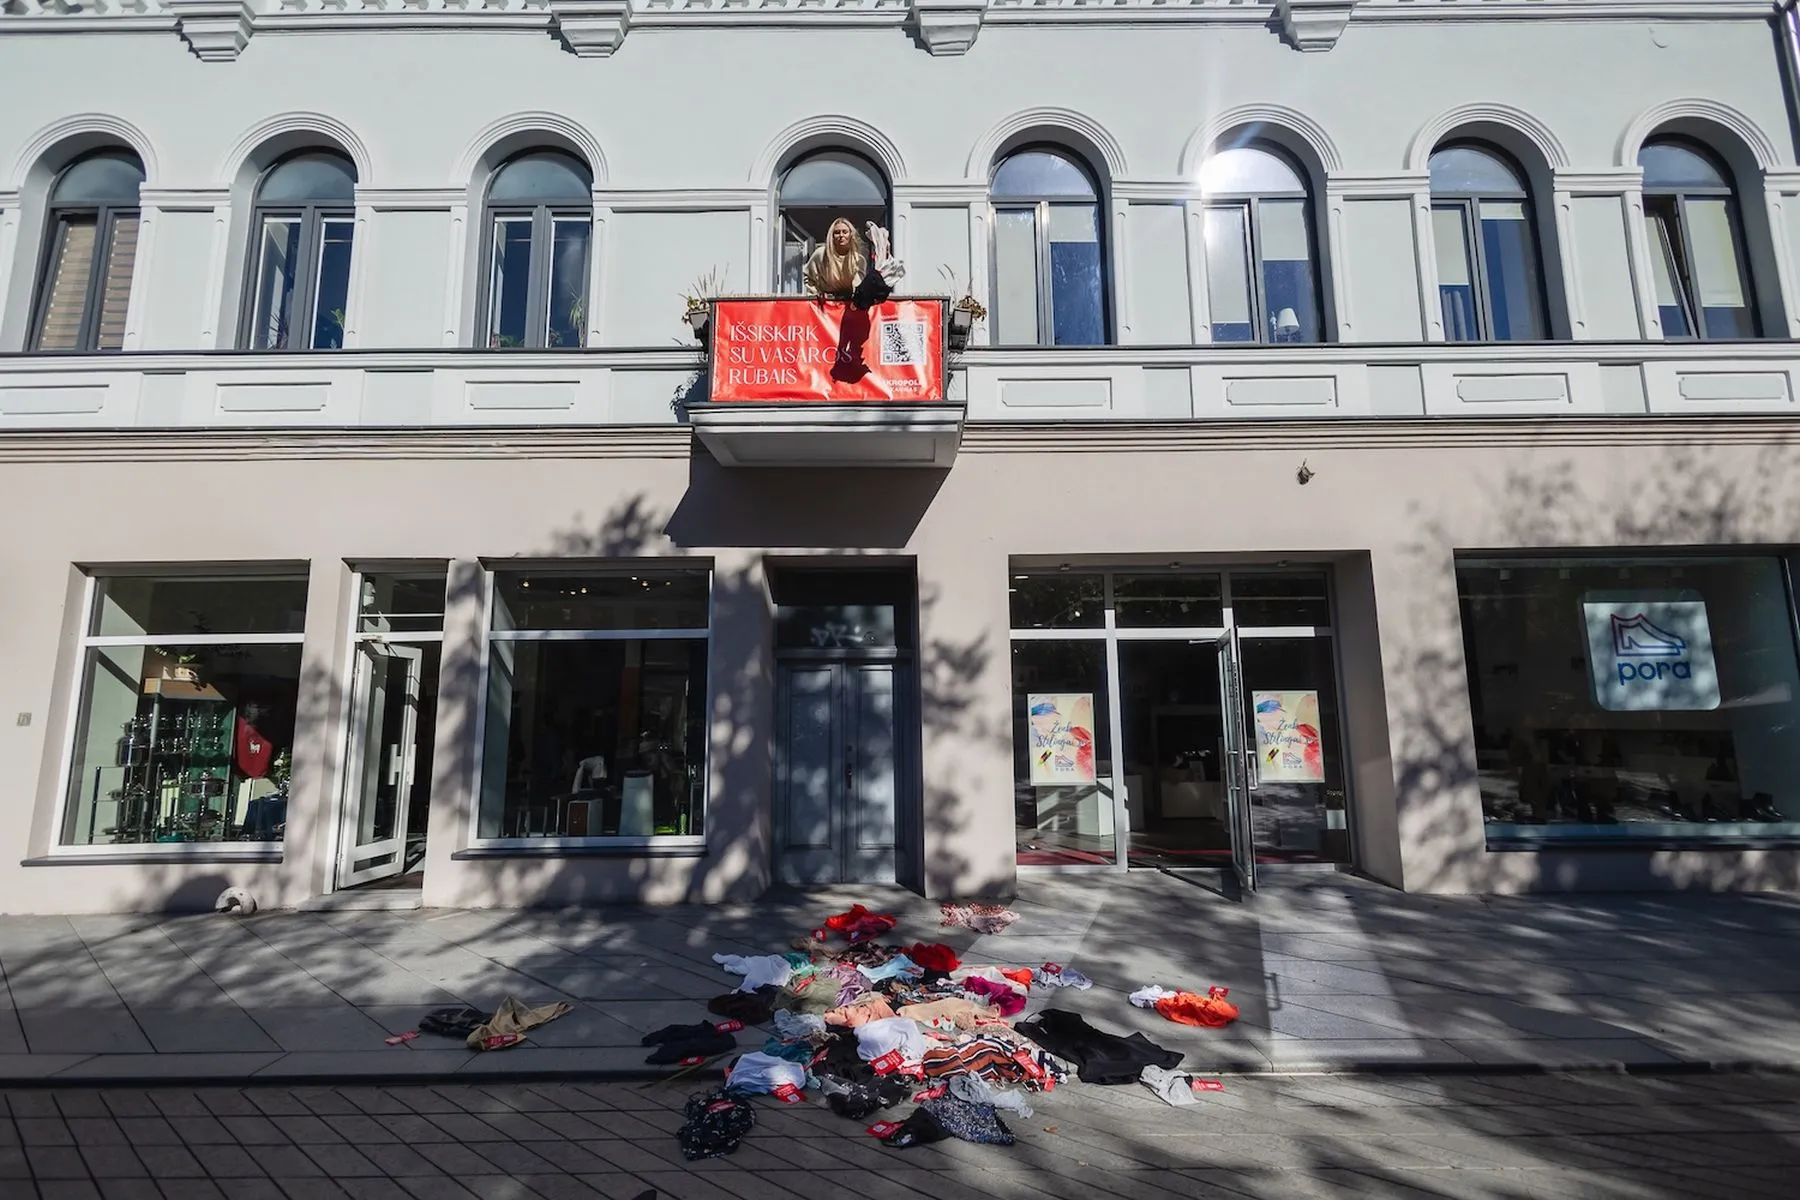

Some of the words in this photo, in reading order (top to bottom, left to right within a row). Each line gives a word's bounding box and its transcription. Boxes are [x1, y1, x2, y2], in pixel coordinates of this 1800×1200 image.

[730, 321, 820, 342] IŠSISKIRK
[729, 346, 756, 364] SU
[759, 346, 853, 364] VASAROS
[728, 365, 798, 385] RŪBAIS
[1617, 661, 1692, 686] pora
